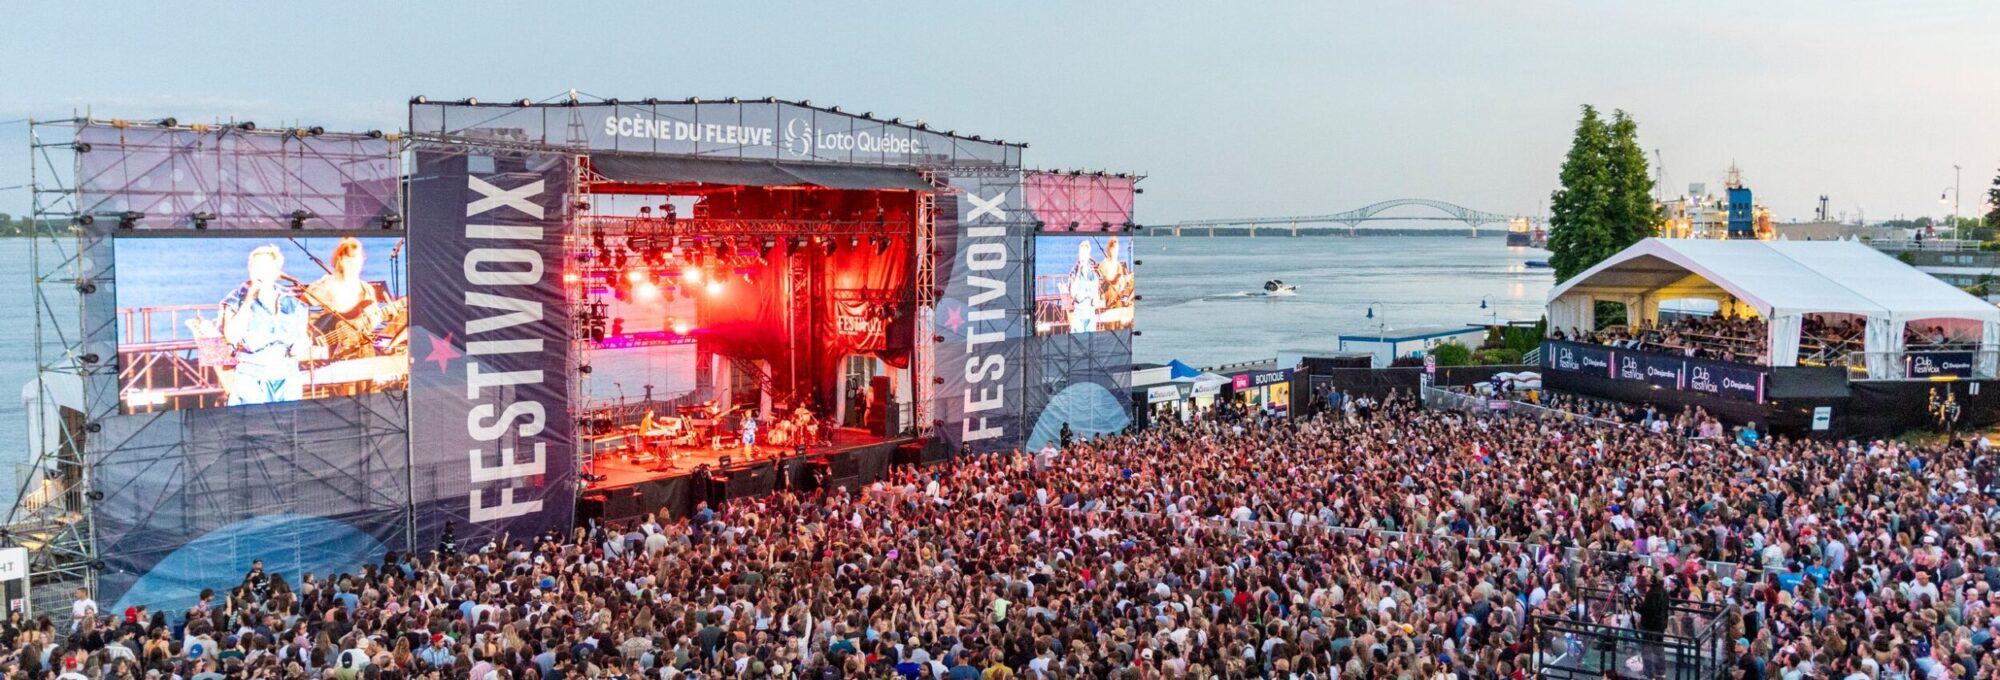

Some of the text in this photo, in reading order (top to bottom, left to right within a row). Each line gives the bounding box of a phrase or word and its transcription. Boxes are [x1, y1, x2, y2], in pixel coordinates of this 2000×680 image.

[604, 113, 772, 147] SCÈNE DU FLEUVE
[818, 129, 920, 154] Loto Québec
[962, 192, 1007, 441] FESTIVOIX
[464, 174, 546, 524] FESTIVOIX
[1255, 371, 1285, 385] BOUTIQUE
